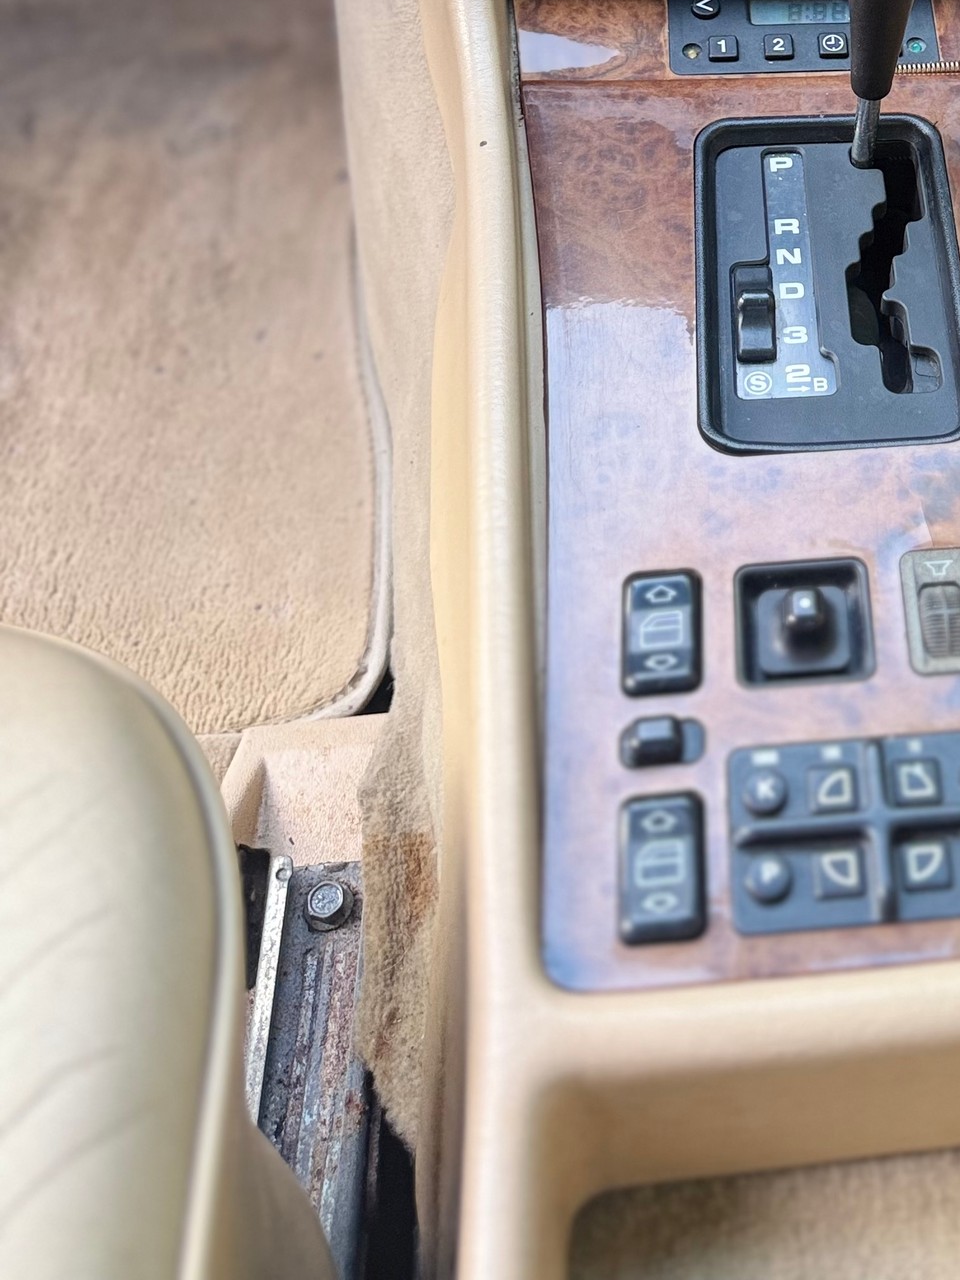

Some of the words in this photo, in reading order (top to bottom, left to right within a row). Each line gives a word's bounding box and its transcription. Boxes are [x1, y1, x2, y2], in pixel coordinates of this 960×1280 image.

[717, 40, 727, 53] 1
[772, 38, 785, 51] 2
[769, 157, 793, 173] P
[773, 218, 800, 235] R
[776, 248, 802, 265] N
[779, 282, 805, 300] D
[783, 326, 808, 344] 3
[785, 364, 811, 384] 2
[749, 376, 767, 392] S
[814, 377, 829, 393] B
[755, 778, 776, 801] K
